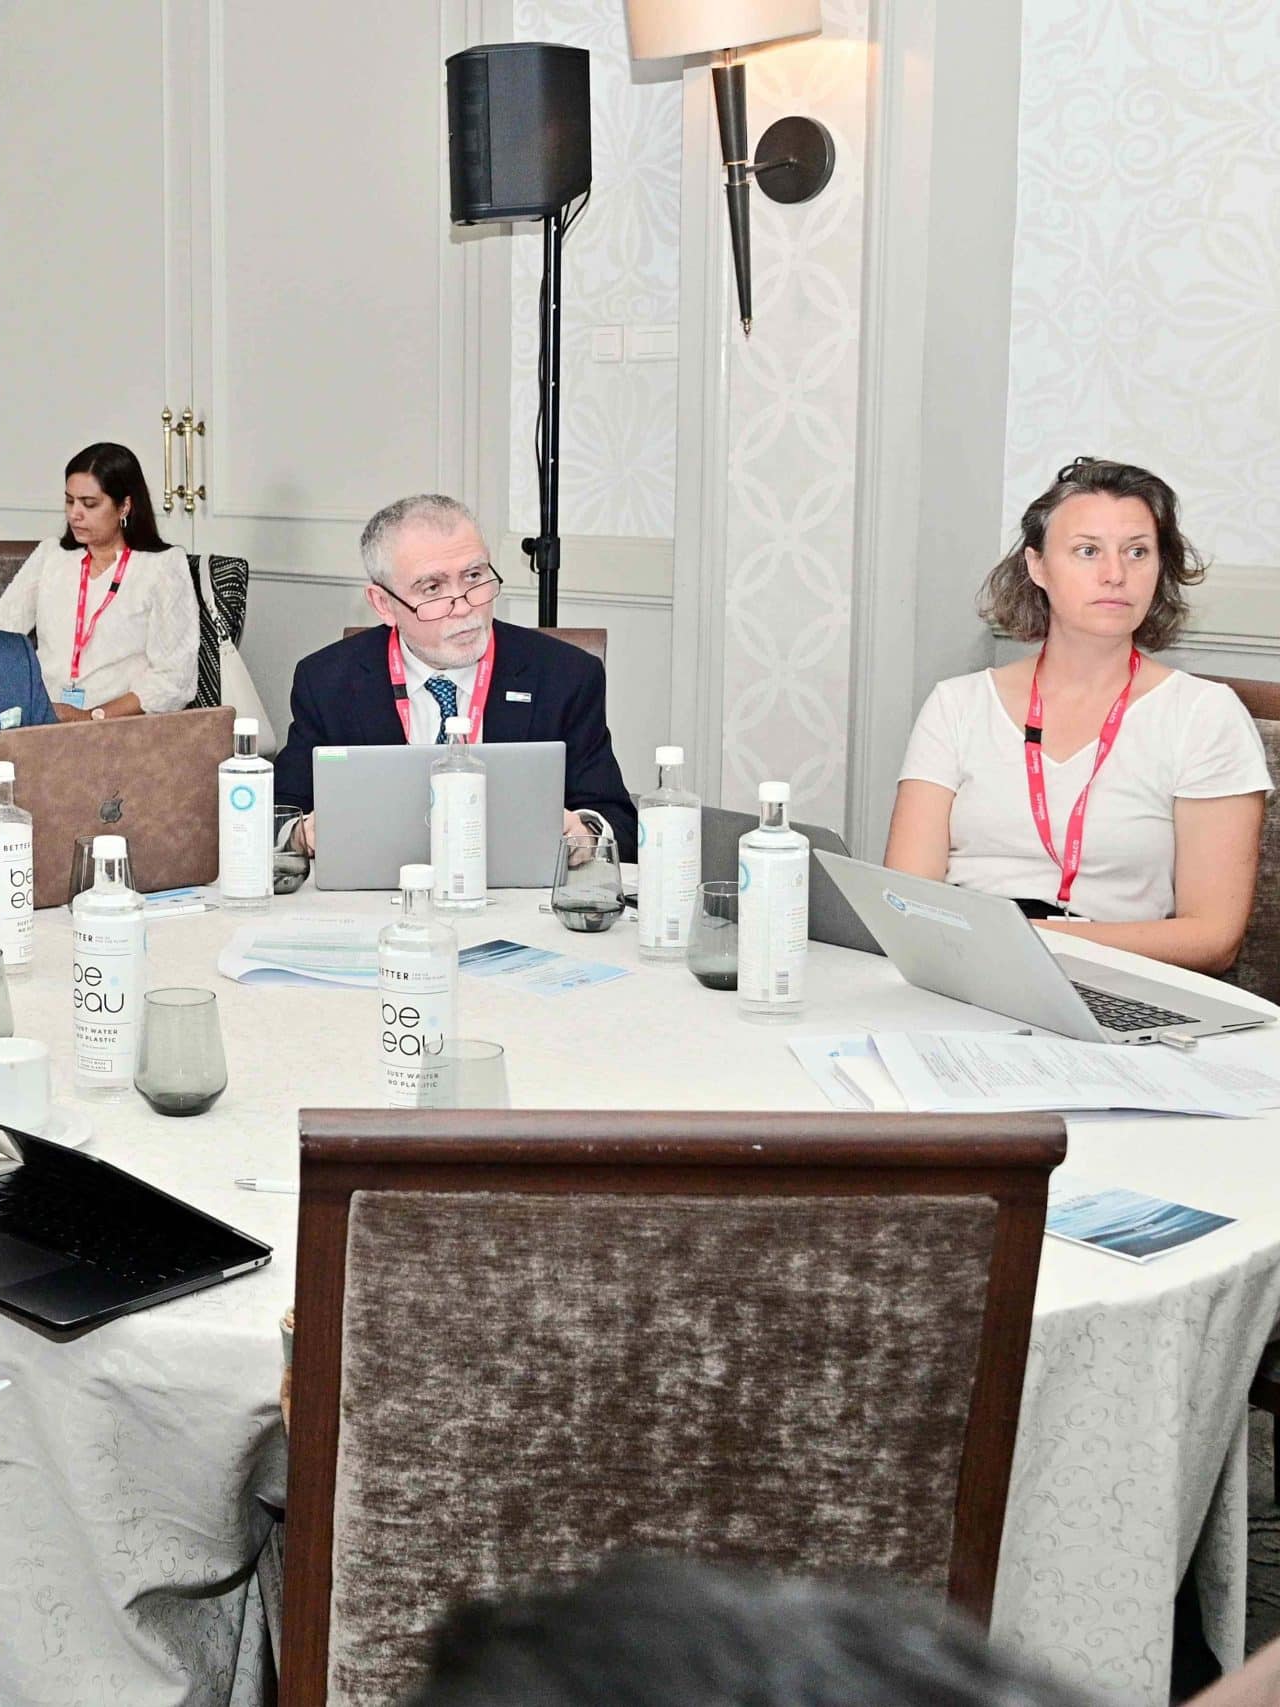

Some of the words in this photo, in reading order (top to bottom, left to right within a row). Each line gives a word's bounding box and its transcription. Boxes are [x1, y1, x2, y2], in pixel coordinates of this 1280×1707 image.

[73, 988, 124, 1013] eau
[382, 998, 420, 1028] be
[382, 1031, 444, 1056] eau
